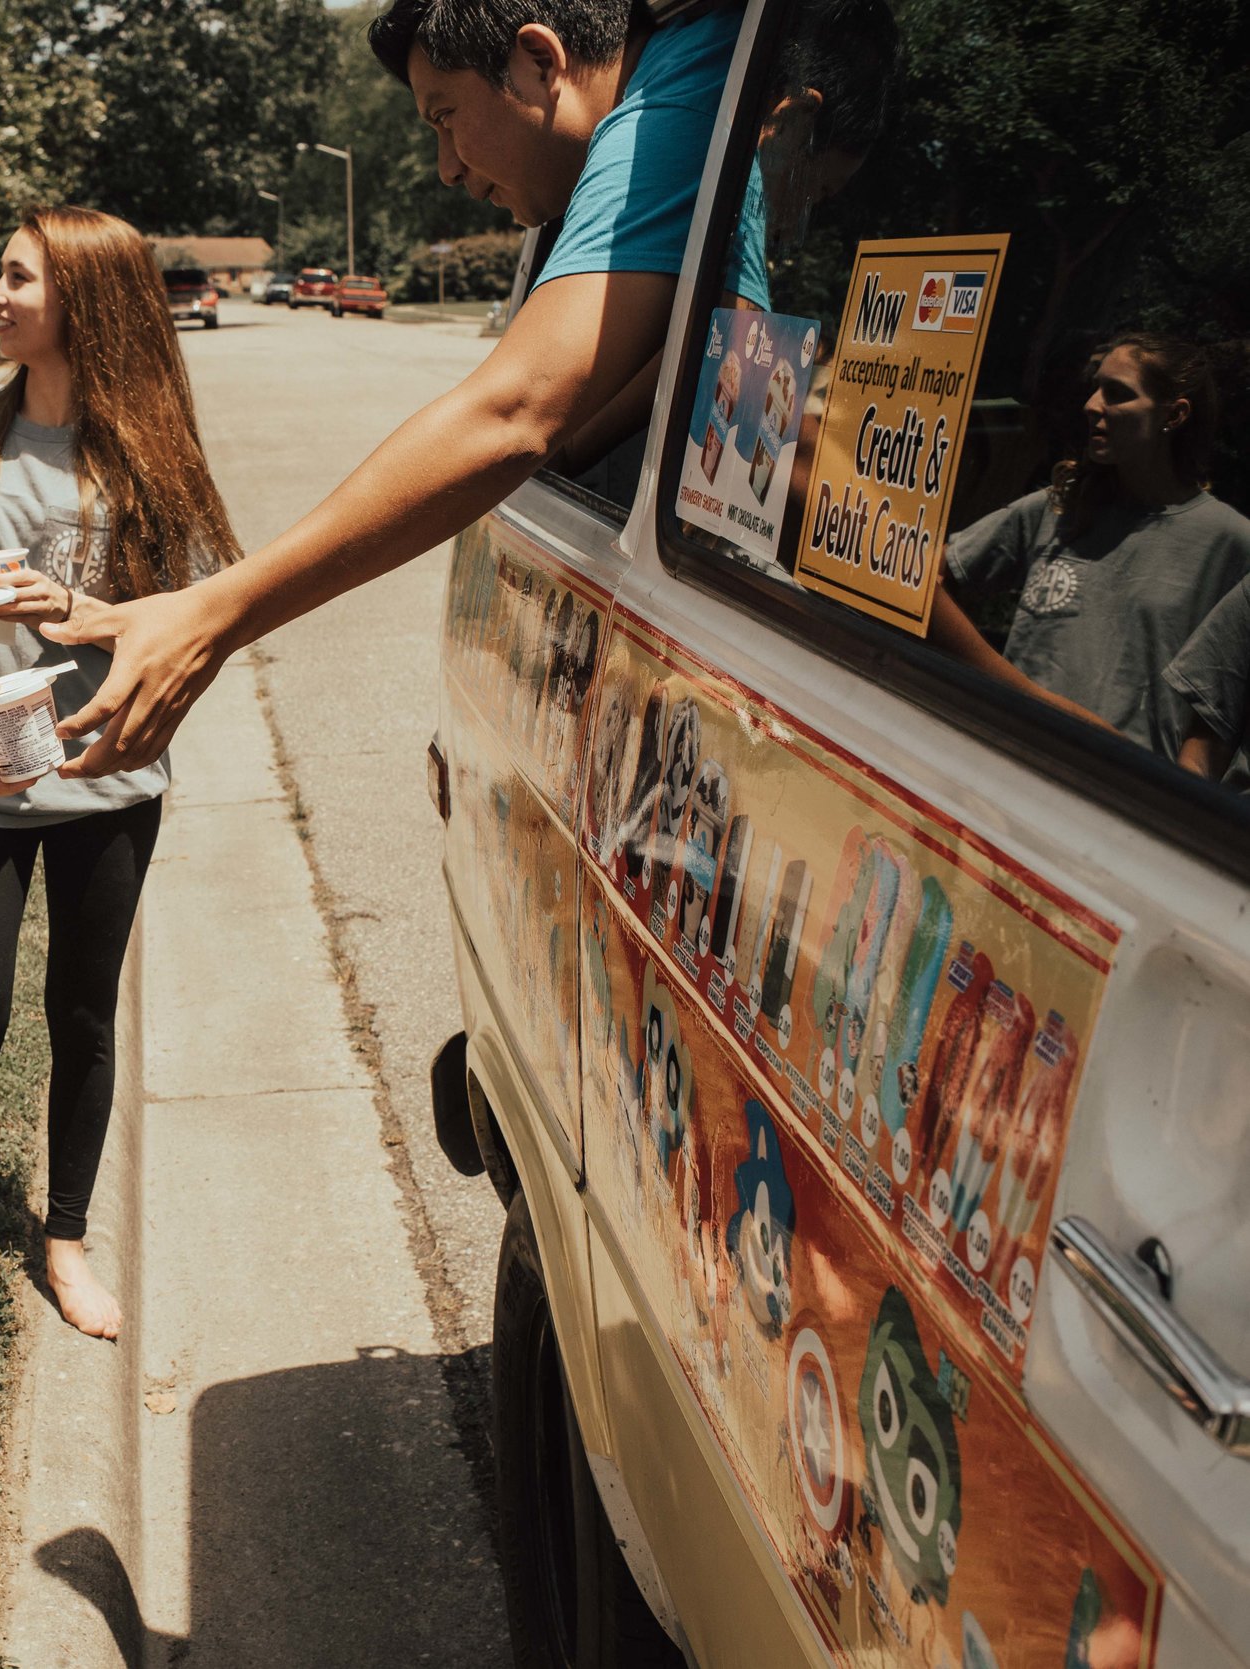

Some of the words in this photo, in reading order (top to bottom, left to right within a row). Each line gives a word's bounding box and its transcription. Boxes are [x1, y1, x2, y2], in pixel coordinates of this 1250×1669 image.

[852, 272, 907, 346] Now
[953, 290, 978, 315] VISA
[839, 354, 900, 399] accepting
[901, 357, 921, 391] all
[919, 361, 965, 406] major
[855, 403, 926, 492] Credit
[924, 415, 949, 498] &
[679, 485, 703, 508] STRAWBERRY
[703, 492, 724, 517] SHORTCAKE
[727, 503, 738, 522] MINT
[738, 508, 760, 534] CHOCOLATE
[810, 480, 870, 568] Debit
[869, 497, 931, 591] Cards
[681, 935, 695, 959] PEANUT
[699, 927, 709, 951] 4.00
[674, 943, 686, 968] BUTTER
[685, 955, 699, 981] BUNNY
[725, 955, 735, 975] 2.00
[707, 984, 724, 1014] VANILLA
[711, 971, 726, 995] SIMPLY
[750, 984, 760, 1007] 2.00
[733, 997, 755, 1032] BIRTHDAY
[734, 1016, 750, 1043] PARTY
[778, 1014, 790, 1040] 2.00
[755, 1033, 782, 1076] NEAPOLITAN
[785, 1060, 820, 1113] WATERMELON
[821, 1060, 834, 1087] 1.00
[840, 1081, 853, 1109] 1.00
[822, 1103, 843, 1138] BUBBLE
[823, 1124, 837, 1151] GUM
[863, 1108, 878, 1136] 1.00
[846, 1130, 868, 1168] COTTON
[893, 1142, 910, 1172] 1.00
[844, 1152, 864, 1186] CANDY
[874, 1164, 892, 1195] SOUR
[866, 1176, 894, 1219] WOWER
[931, 1184, 949, 1215] 1.00
[903, 1193, 945, 1245] STRAWBERRY
[902, 1215, 939, 1269] RASPBERRY
[970, 1224, 989, 1258] 1.00
[942, 1247, 975, 1297] ORIGINAL
[1012, 1273, 1032, 1308] 1.00
[977, 1278, 1027, 1348] STRAWBERRY
[981, 1309, 1014, 1363] BANANA
